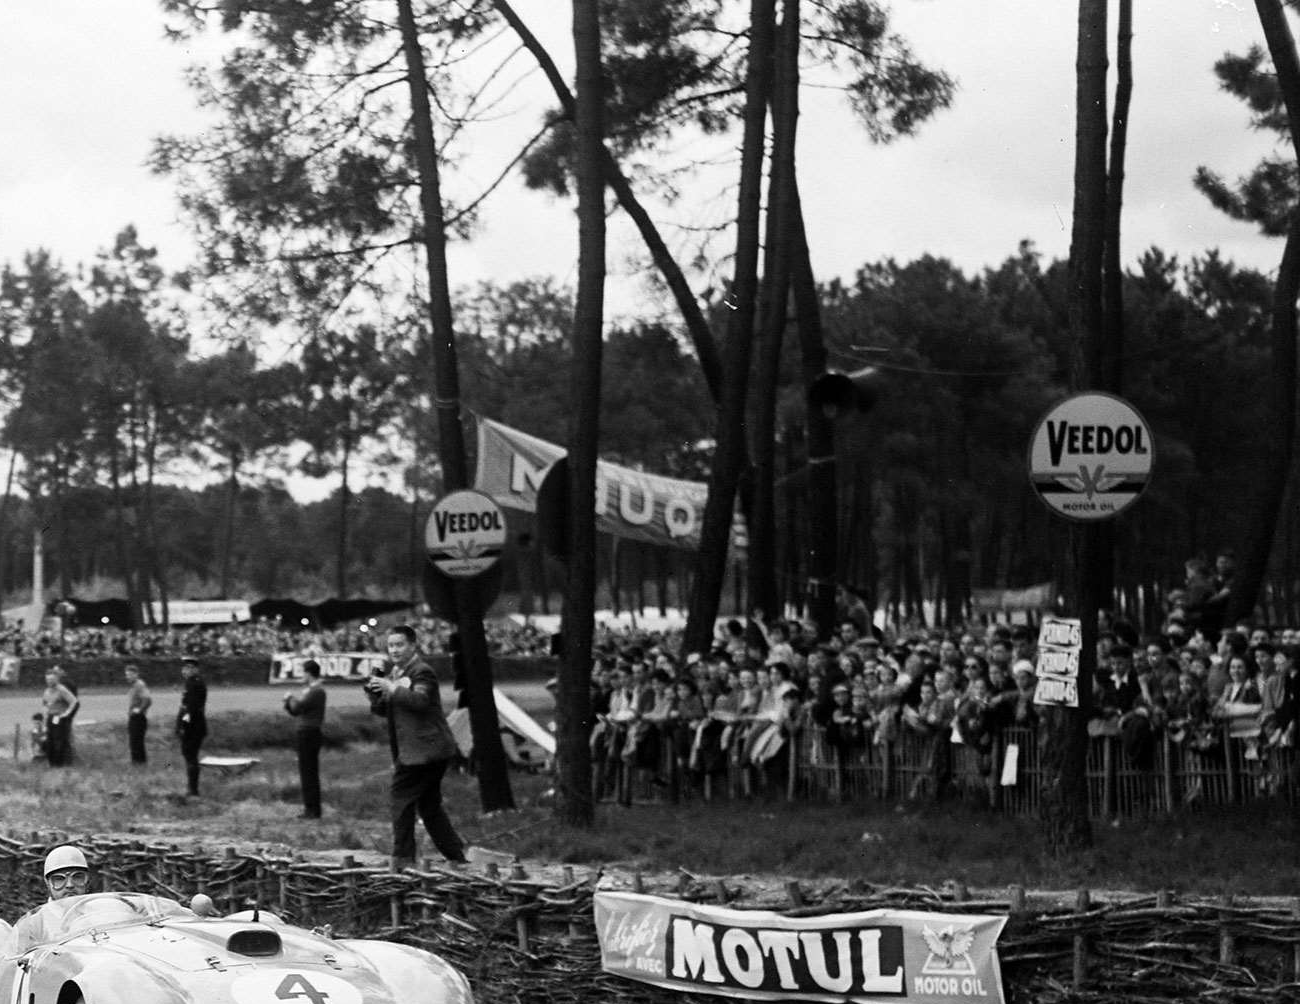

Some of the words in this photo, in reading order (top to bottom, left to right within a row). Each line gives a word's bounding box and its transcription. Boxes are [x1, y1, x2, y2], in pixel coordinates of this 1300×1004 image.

[1046, 420, 1148, 467] VEEDOL
[1062, 502, 1097, 512] MOTOR
[434, 510, 503, 543] VEEDOL
[636, 956, 663, 974] AVEC
[671, 917, 904, 994] MOTUL
[913, 975, 959, 997] MOTOR
[961, 977, 988, 997] OIL
